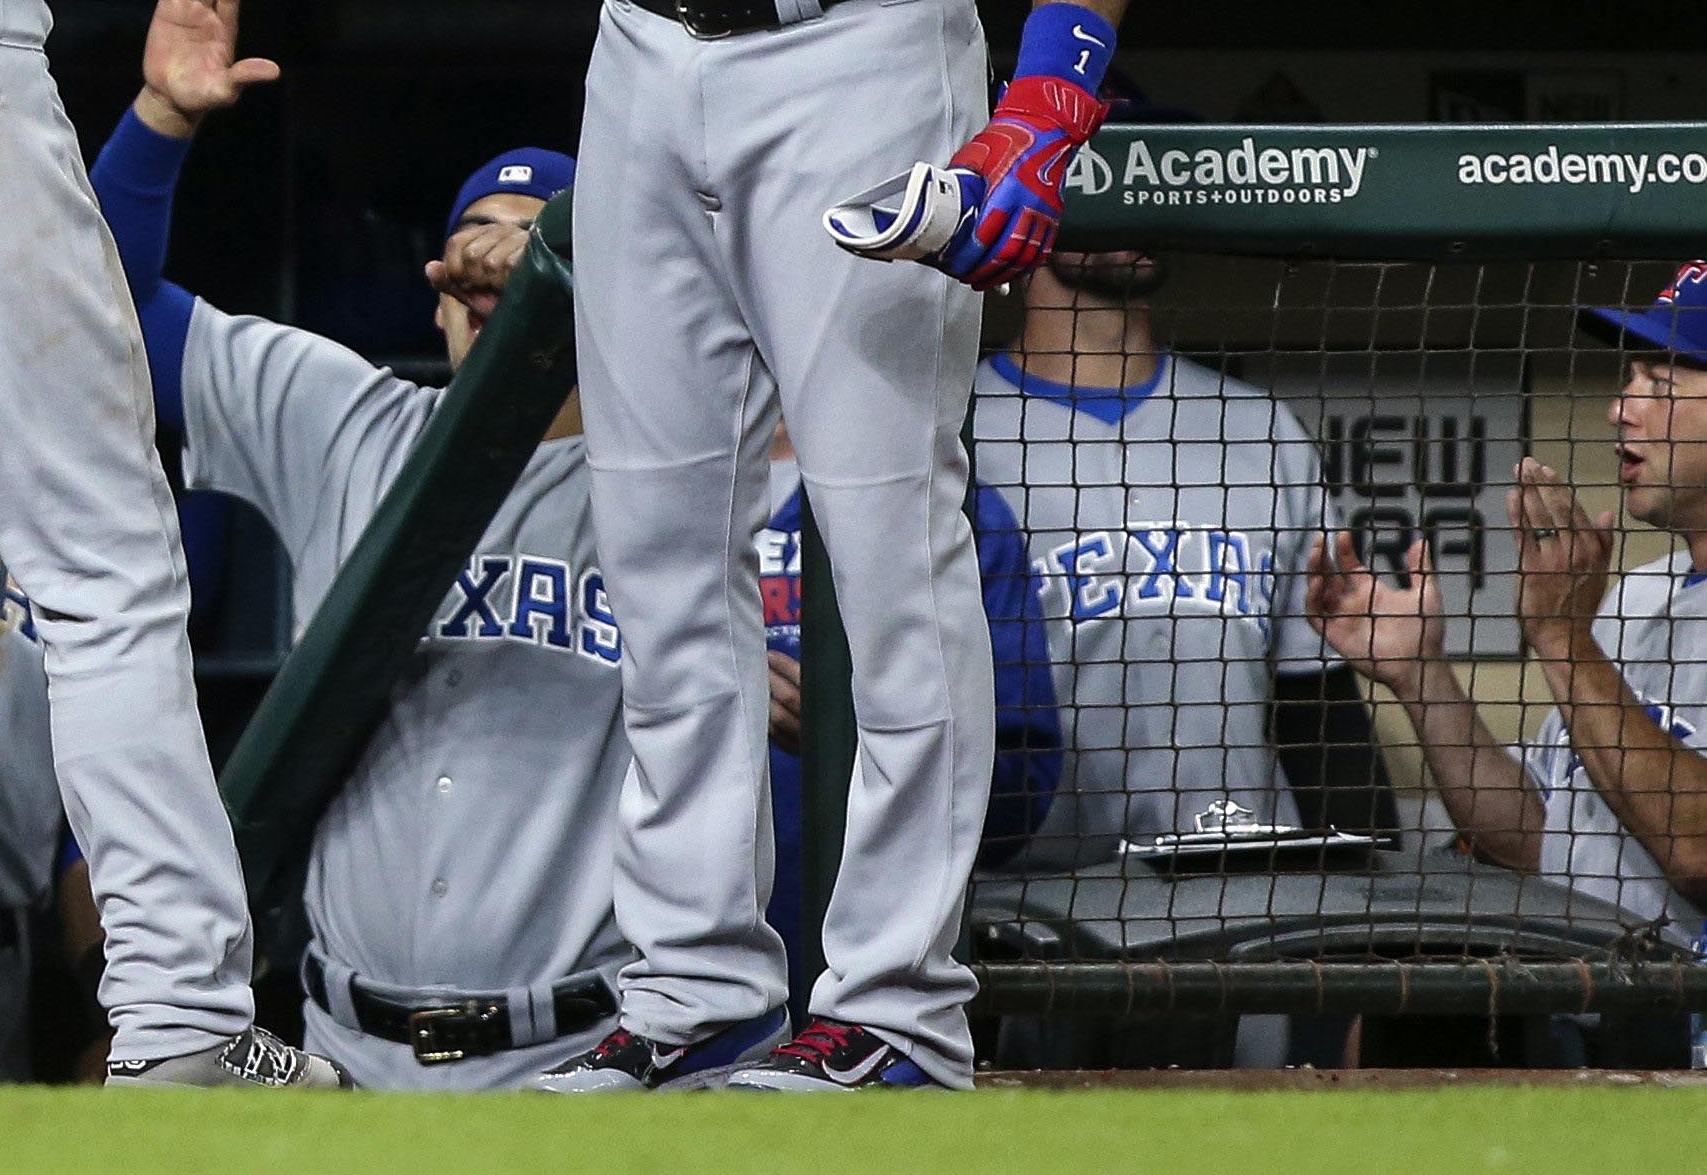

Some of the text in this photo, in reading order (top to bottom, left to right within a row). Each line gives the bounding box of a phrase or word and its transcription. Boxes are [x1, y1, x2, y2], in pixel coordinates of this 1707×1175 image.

[1073, 50, 1091, 76] 1
[1122, 137, 1367, 198] Academy
[1458, 145, 1707, 194] academy.co
[1123, 188, 1342, 205] SPORTS+OUTDOORS
[1343, 505, 1487, 590] RA
[436, 553, 623, 668] XAS
